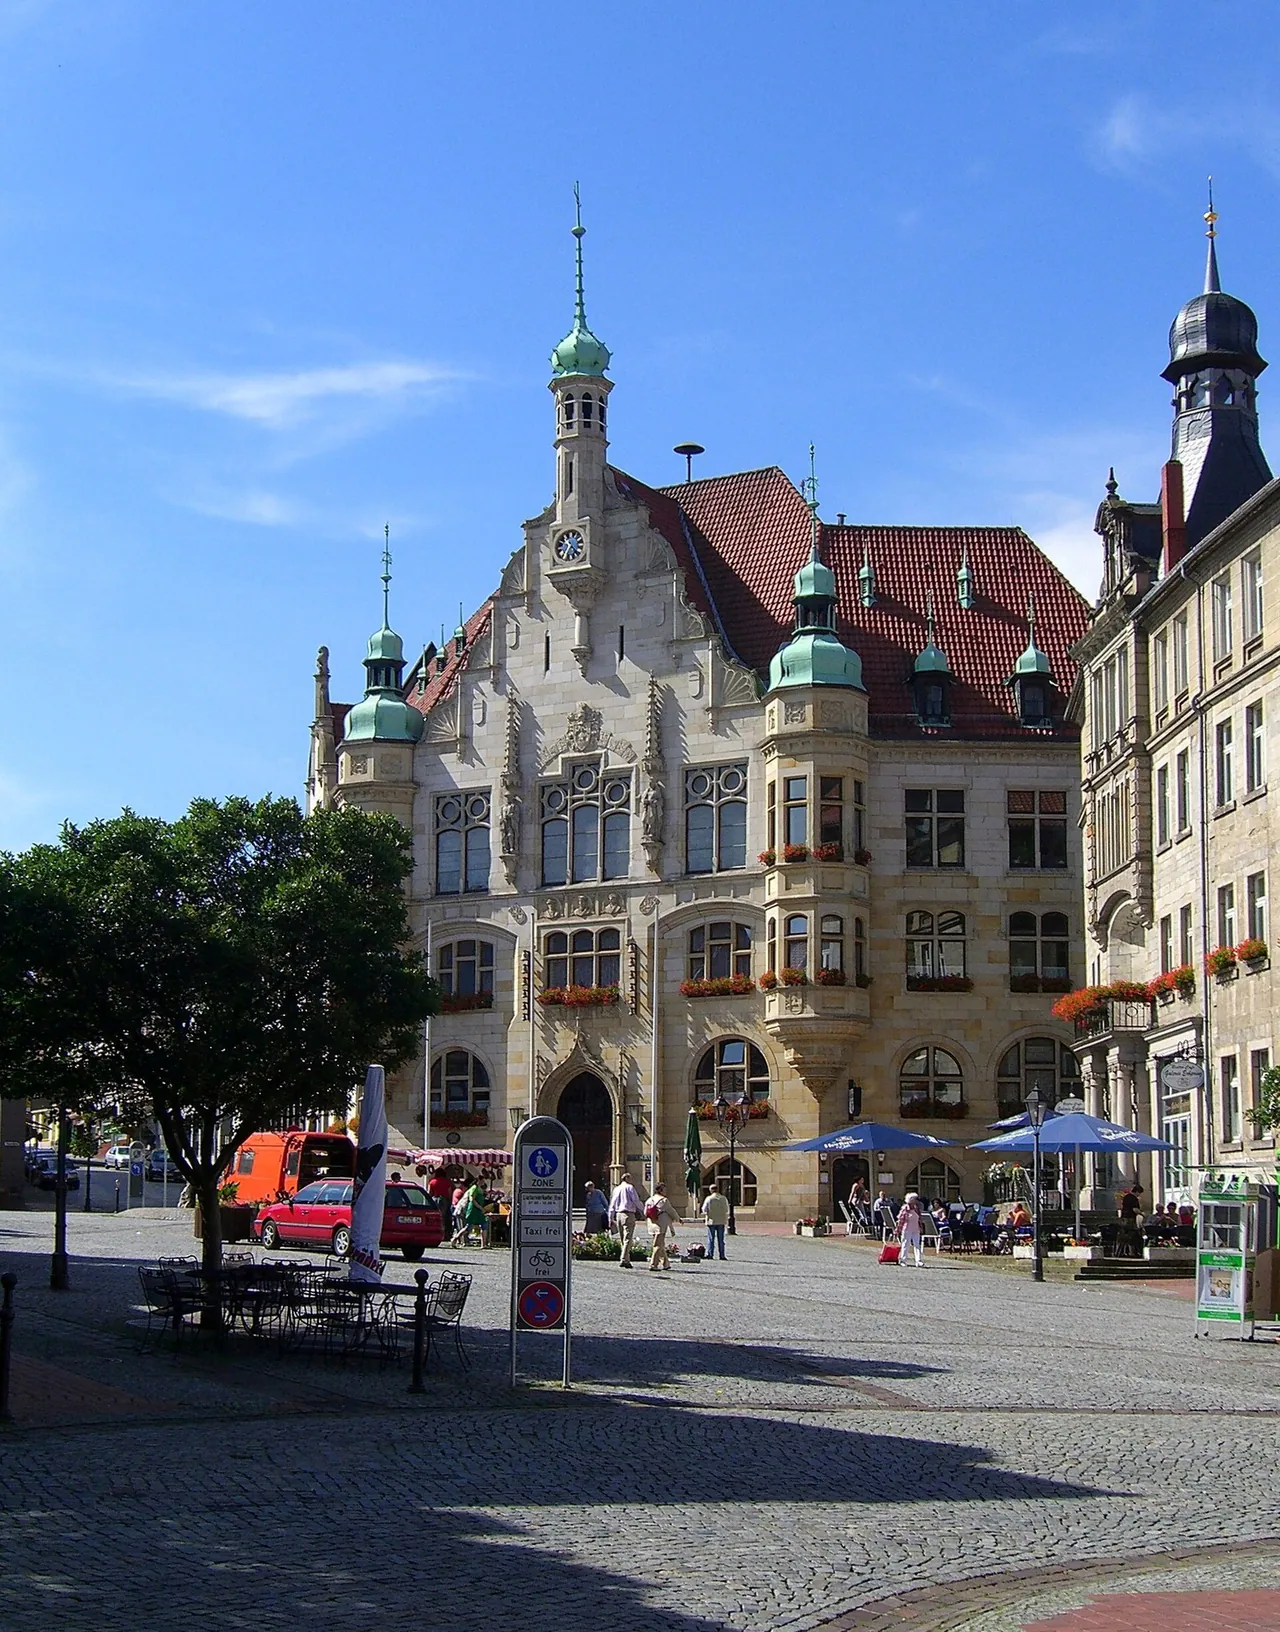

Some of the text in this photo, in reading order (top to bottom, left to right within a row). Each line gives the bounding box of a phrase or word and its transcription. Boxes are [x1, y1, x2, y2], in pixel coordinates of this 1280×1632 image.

[531, 1179, 554, 1187] ZONE
[1204, 1181, 1239, 1190] PORAS
[524, 1226, 561, 1236] Taxi frei
[535, 1267, 550, 1276] frei
